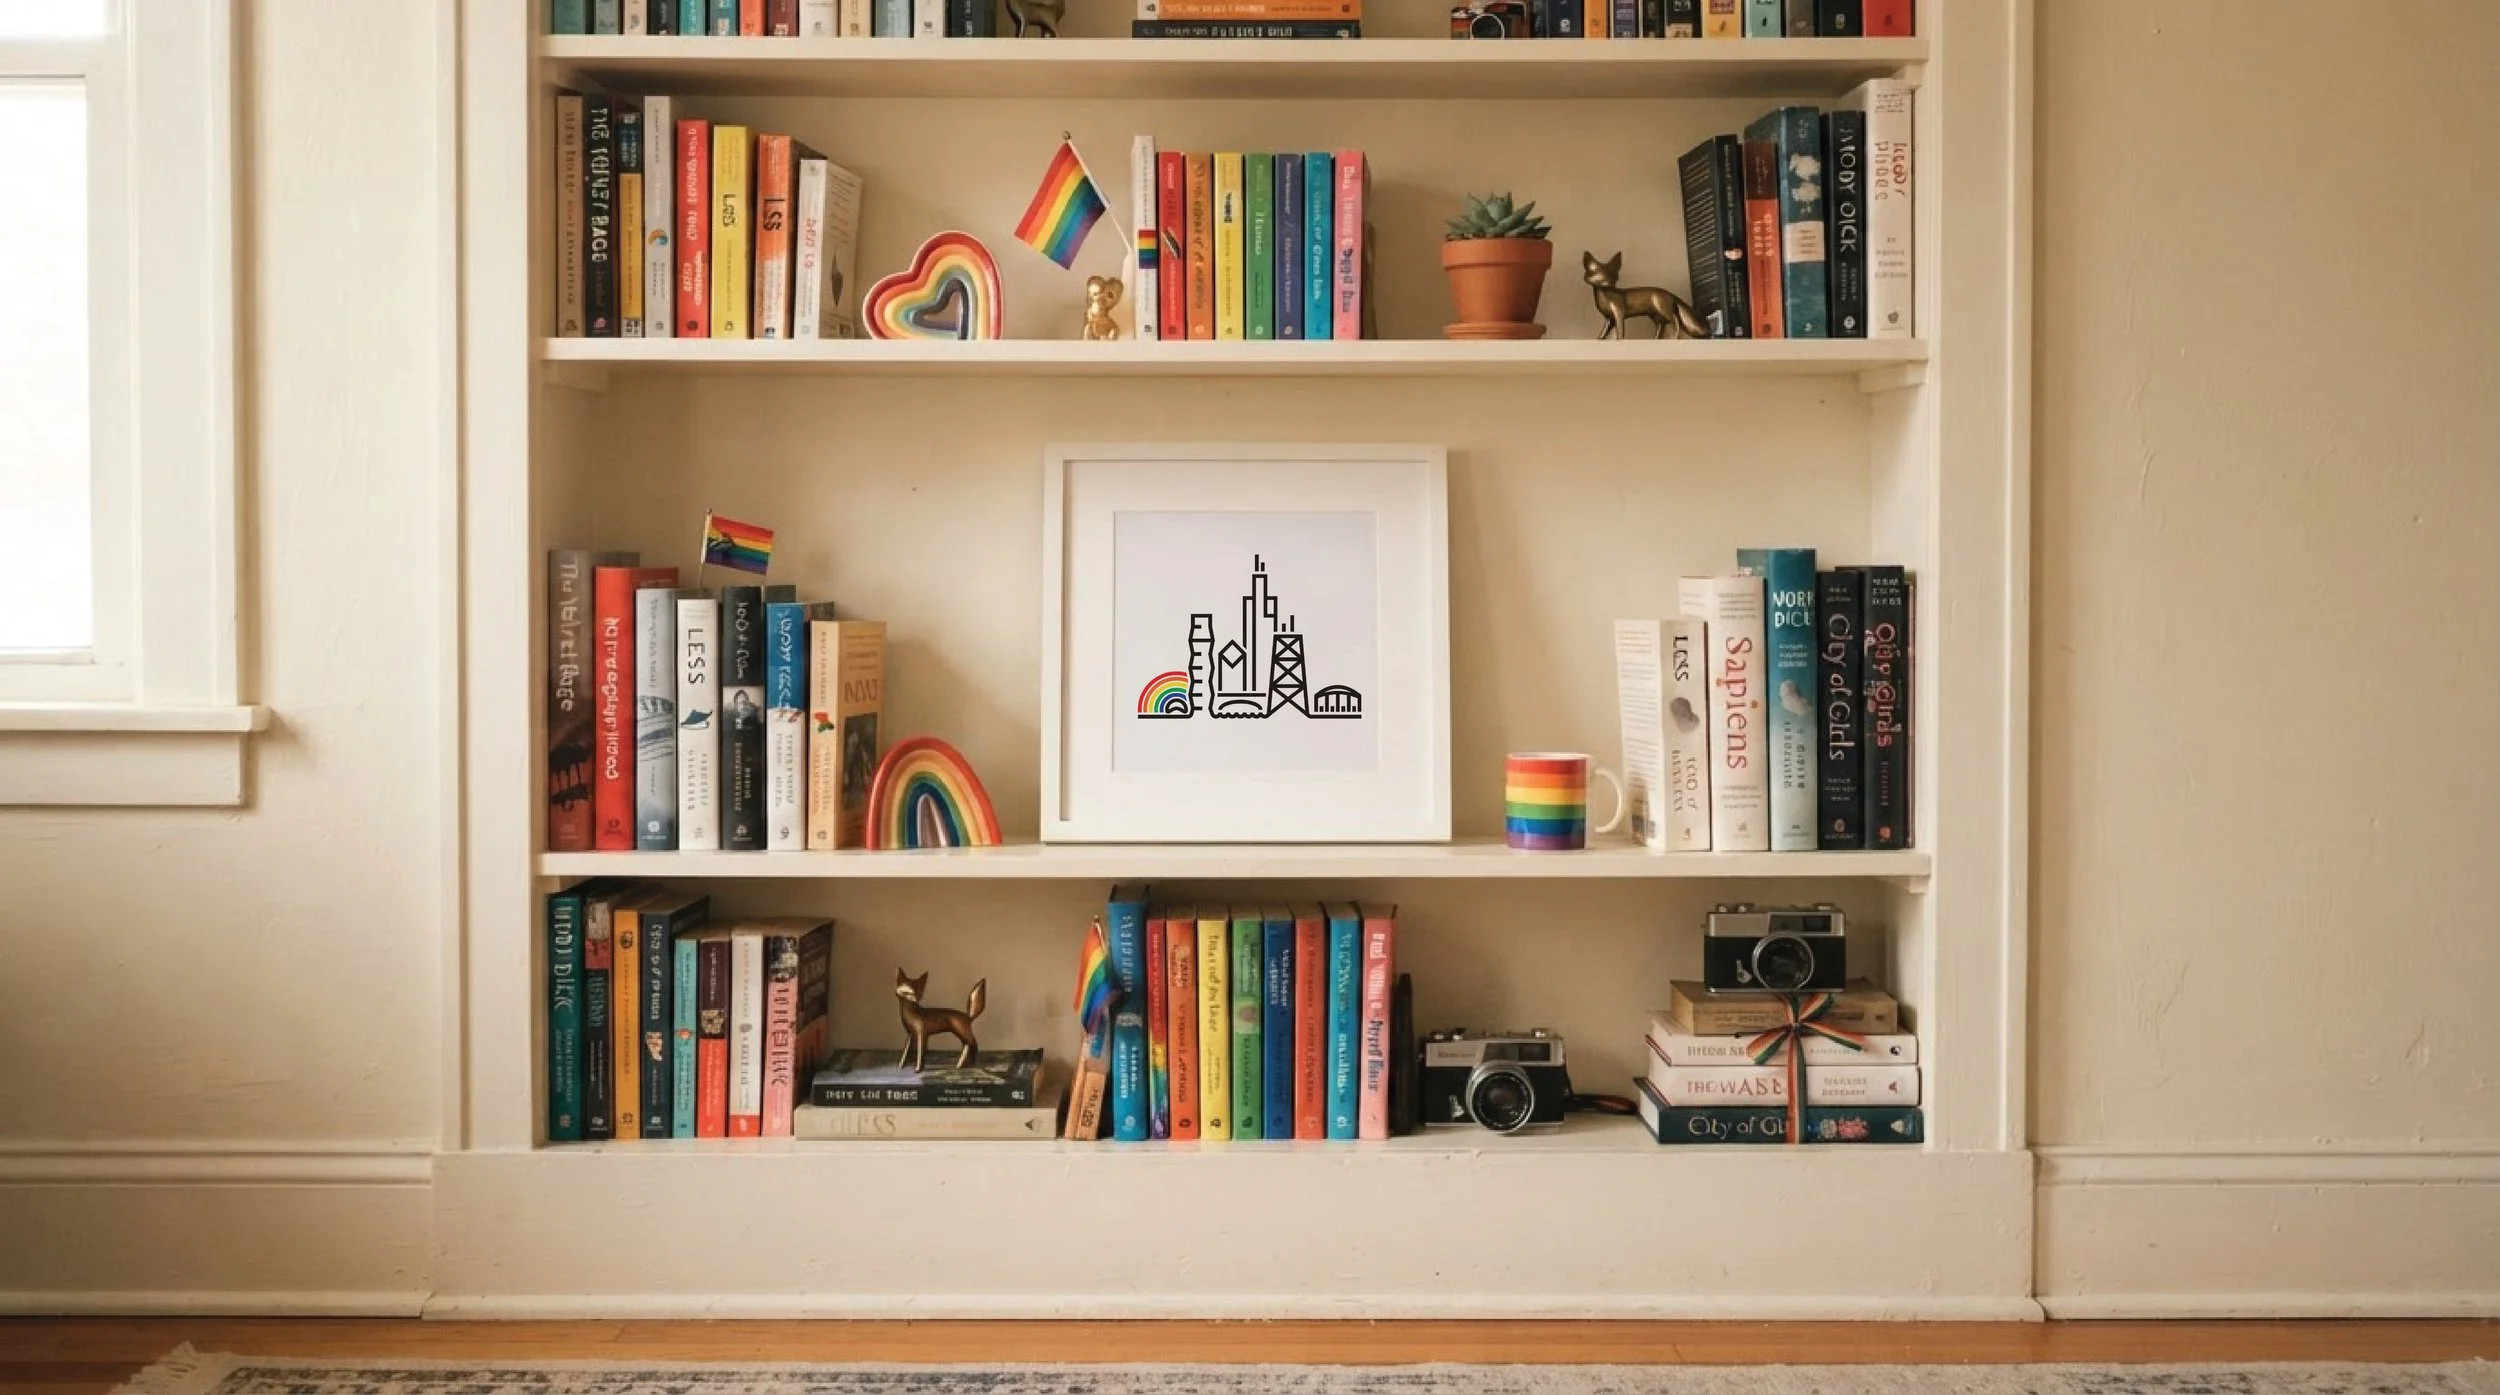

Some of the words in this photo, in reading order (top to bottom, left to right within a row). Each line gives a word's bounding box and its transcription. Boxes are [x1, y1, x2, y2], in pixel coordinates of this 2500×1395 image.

[687, 628, 706, 685] LESS
[1716, 636, 1759, 769] Sapiens
[1688, 1116, 1733, 1140] City
[1737, 1116, 1757, 1133] of
